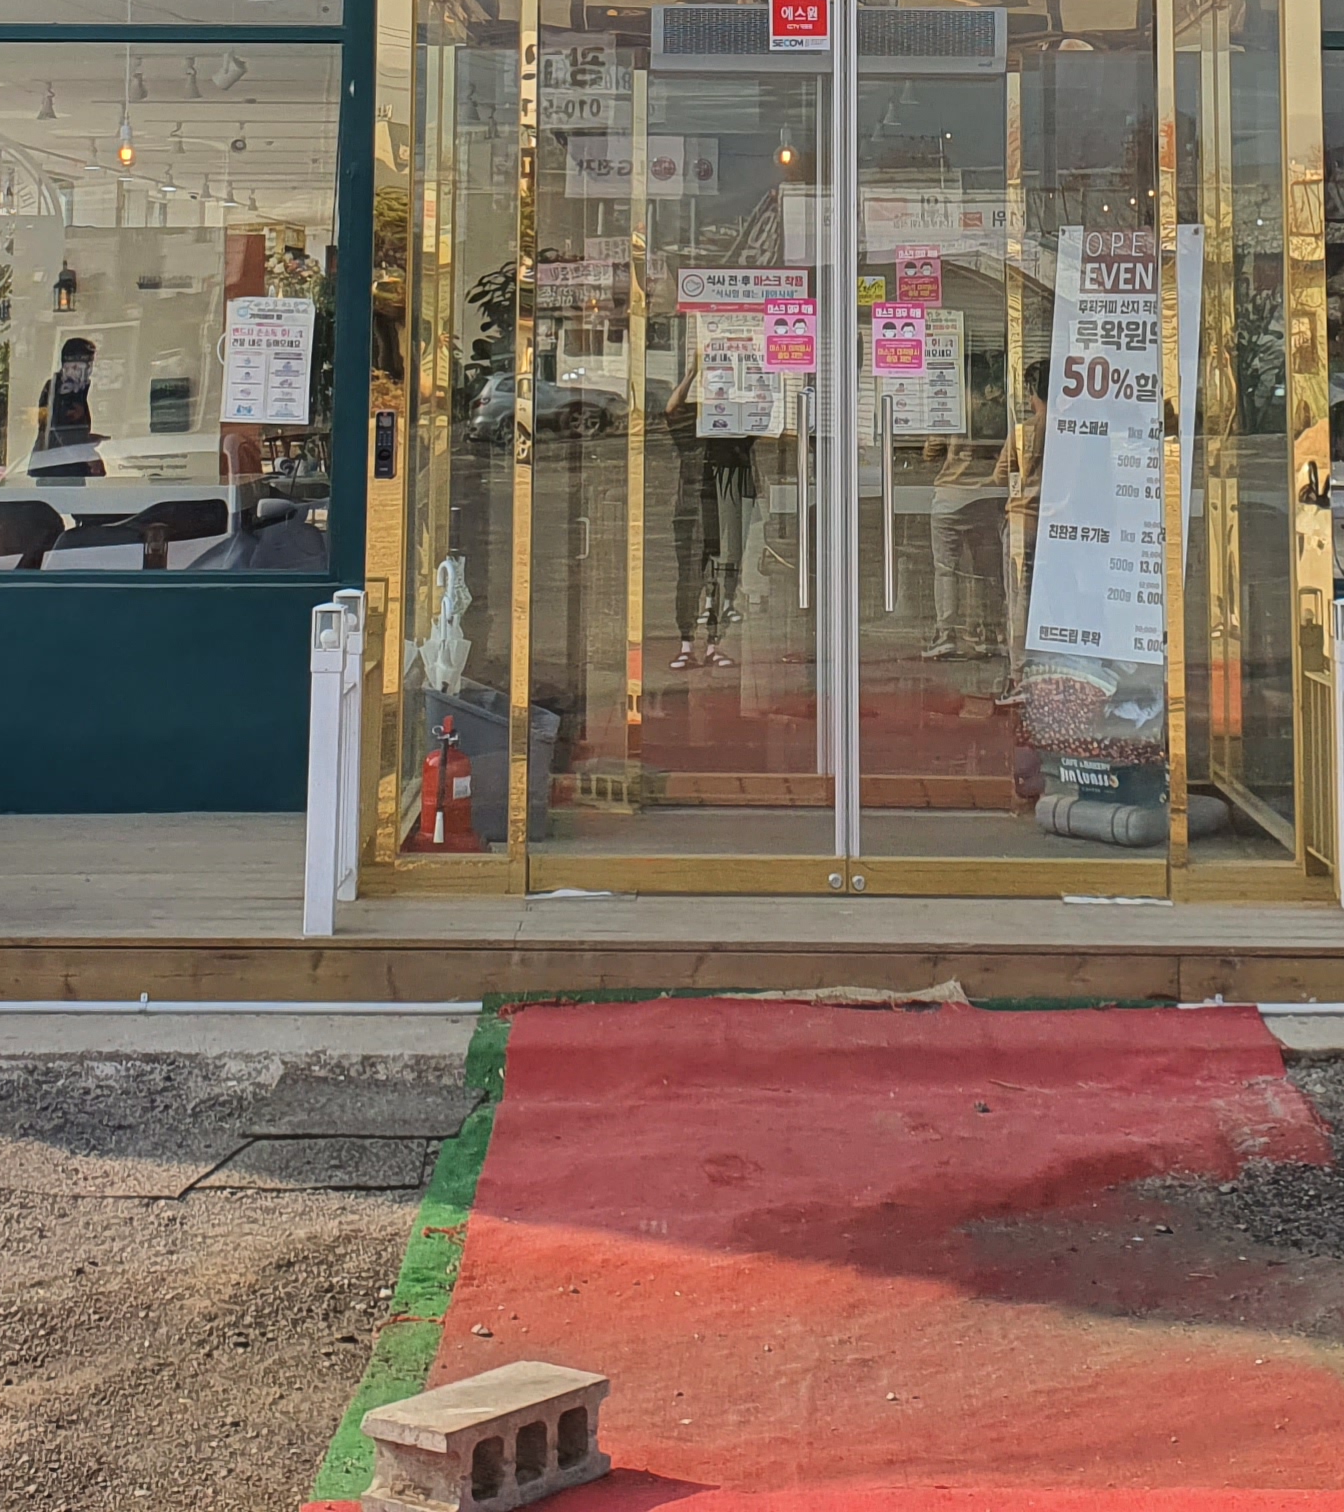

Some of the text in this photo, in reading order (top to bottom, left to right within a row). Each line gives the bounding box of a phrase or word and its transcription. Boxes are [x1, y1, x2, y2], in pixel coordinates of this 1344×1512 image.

[781, 5, 819, 21] 에스원
[772, 38, 804, 48] SECOM
[1086, 231, 1156, 257] OPE
[753, 276, 782, 287] 마스크
[1117, 454, 1141, 469] 500g
[1116, 484, 1140, 498] 200g
[1048, 523, 1078, 540] 친환경
[1080, 526, 1111, 544] 유기농
[1109, 557, 1134, 573] 500g
[1106, 587, 1132, 603] 200g
